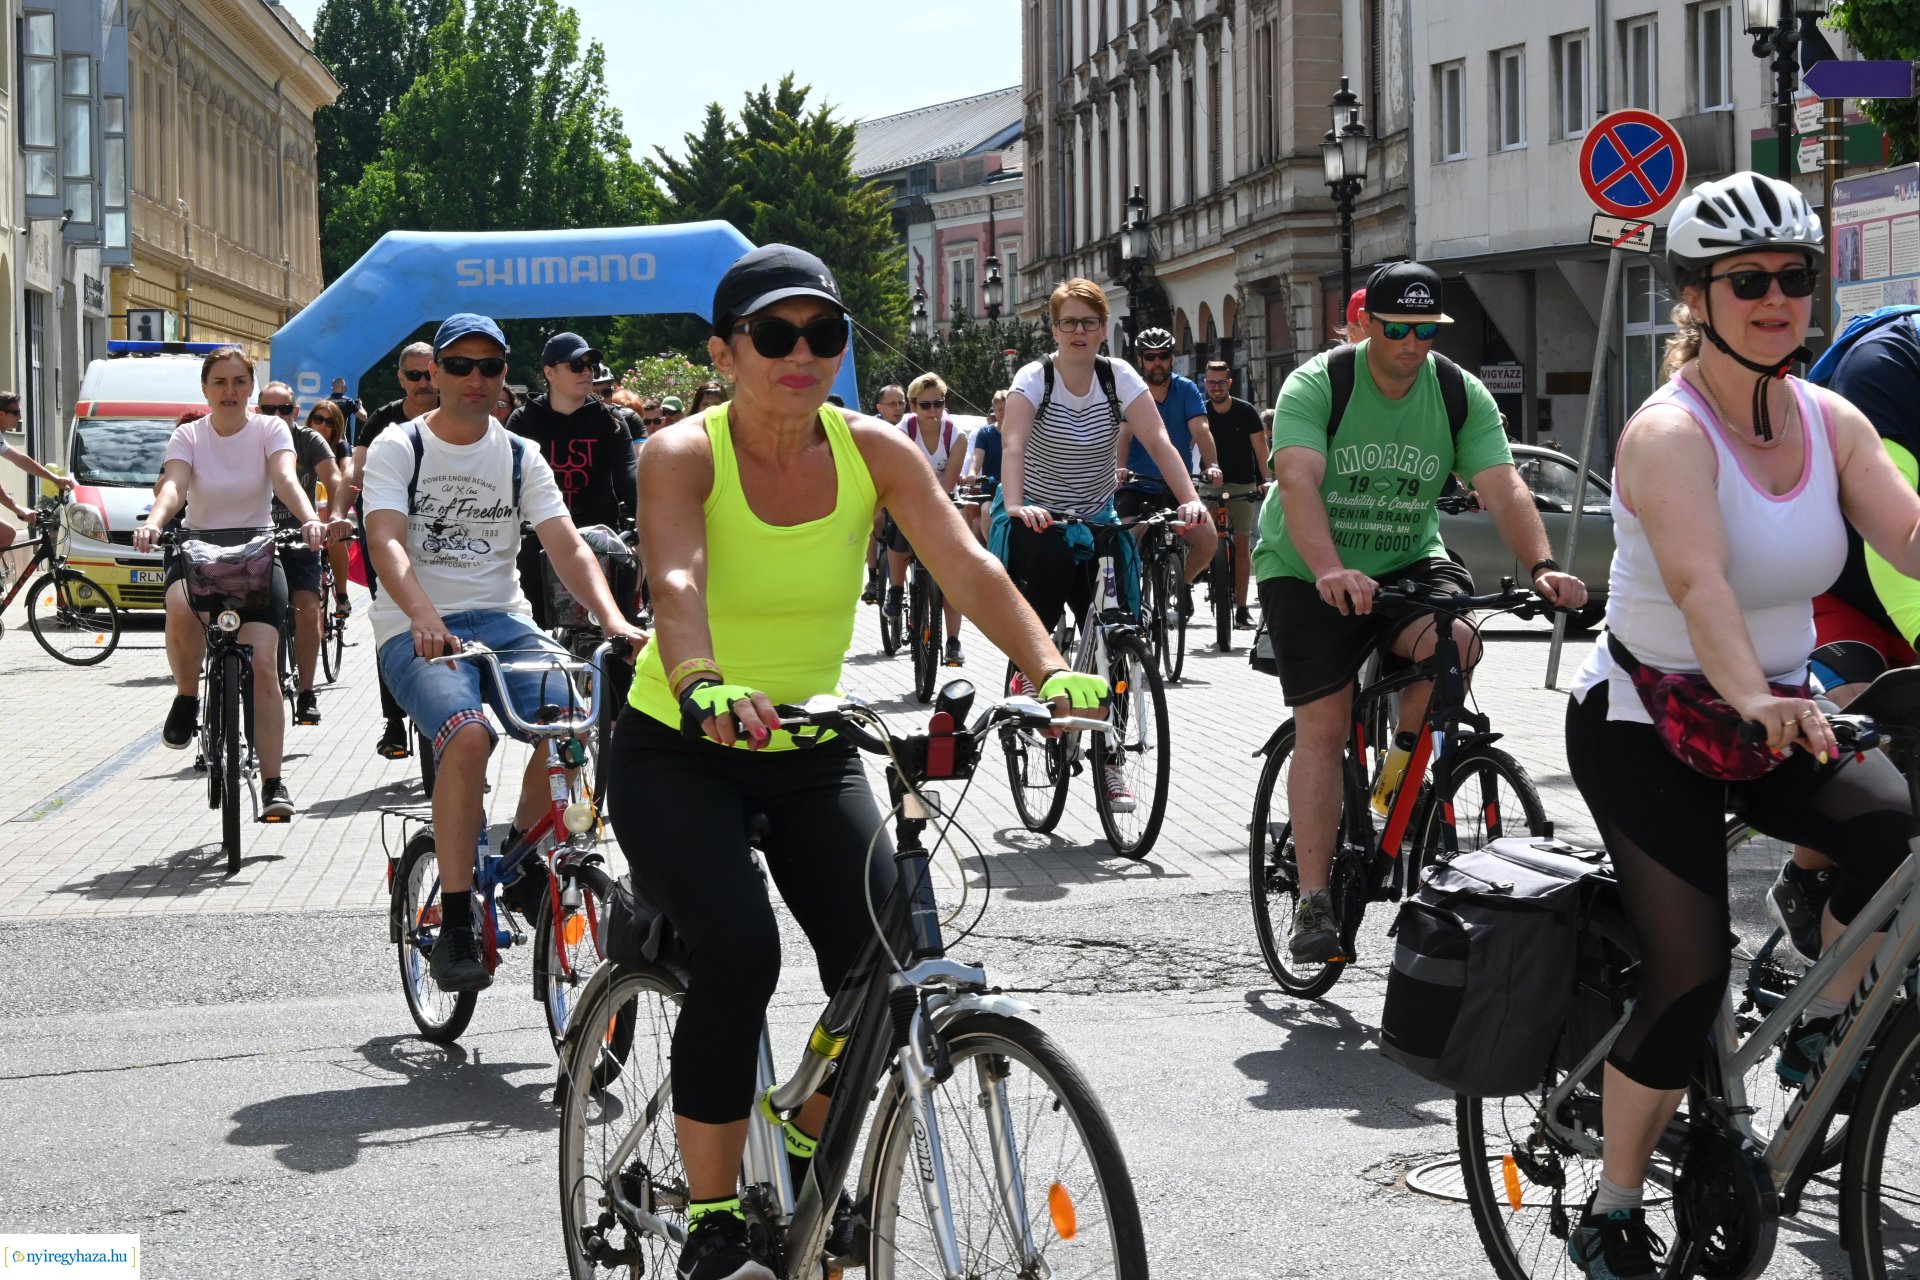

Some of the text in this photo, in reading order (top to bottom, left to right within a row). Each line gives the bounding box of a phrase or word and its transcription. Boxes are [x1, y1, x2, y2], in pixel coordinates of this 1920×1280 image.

[456, 253, 656, 286] SHIMANO
[1481, 368, 1521, 379] VIGYÁZZ
[1483, 381, 1521, 389] UTÓKIJÁRAT
[1335, 443, 1440, 481] MORRO
[423, 476, 448, 485] POWER
[472, 477, 496, 491] REPAIRS
[1349, 475, 1420, 497] 19 79
[438, 497, 459, 519] of
[456, 498, 513, 521] Freedom
[1327, 491, 1430, 512] Durability & Comfort
[1330, 507, 1421, 524] DENIM BRAND
[1335, 521, 1358, 530] KUALA
[1360, 522, 1394, 533] LUMPUR,
